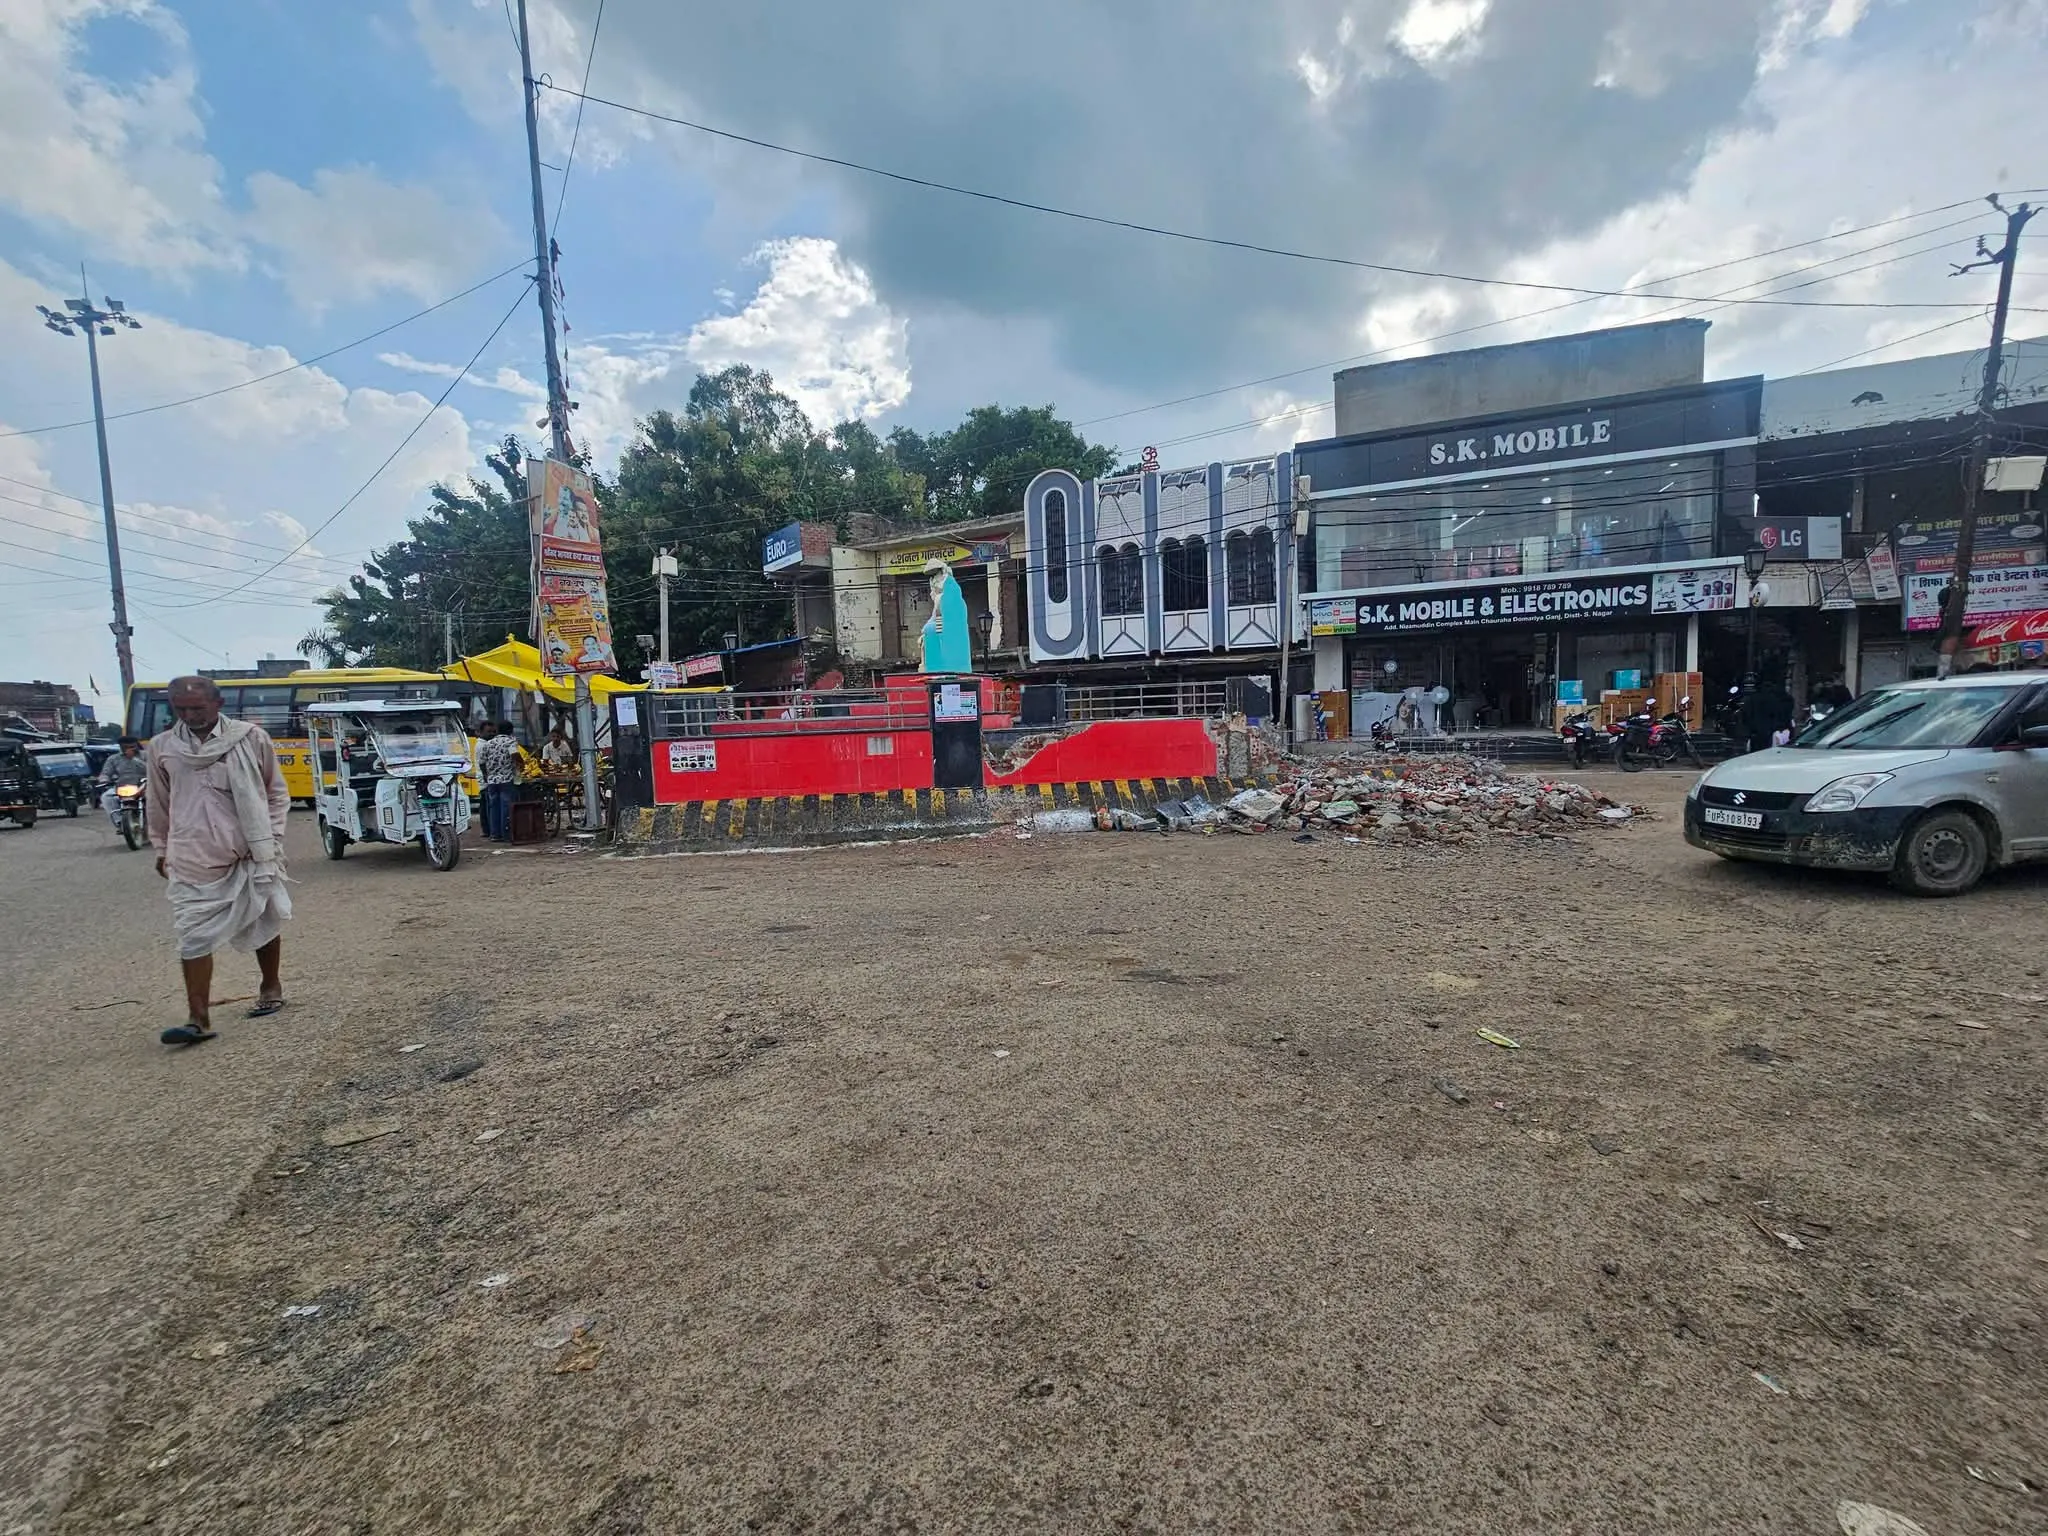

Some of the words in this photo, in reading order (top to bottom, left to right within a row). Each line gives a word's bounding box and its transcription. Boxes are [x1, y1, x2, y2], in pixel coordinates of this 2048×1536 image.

[1430, 438, 1487, 465] S.K.
[1493, 419, 1611, 457] MOBILE
[1781, 529, 1802, 546] LG
[766, 539, 787, 563] EURO
[1543, 583, 1556, 591] 789
[1359, 604, 1395, 624] S.K.
[1400, 598, 1475, 622] MOBILE
[1479, 597, 1495, 616] &
[1500, 584, 1648, 615] ELECTRONICS
[1436, 620, 1463, 628] Complex
